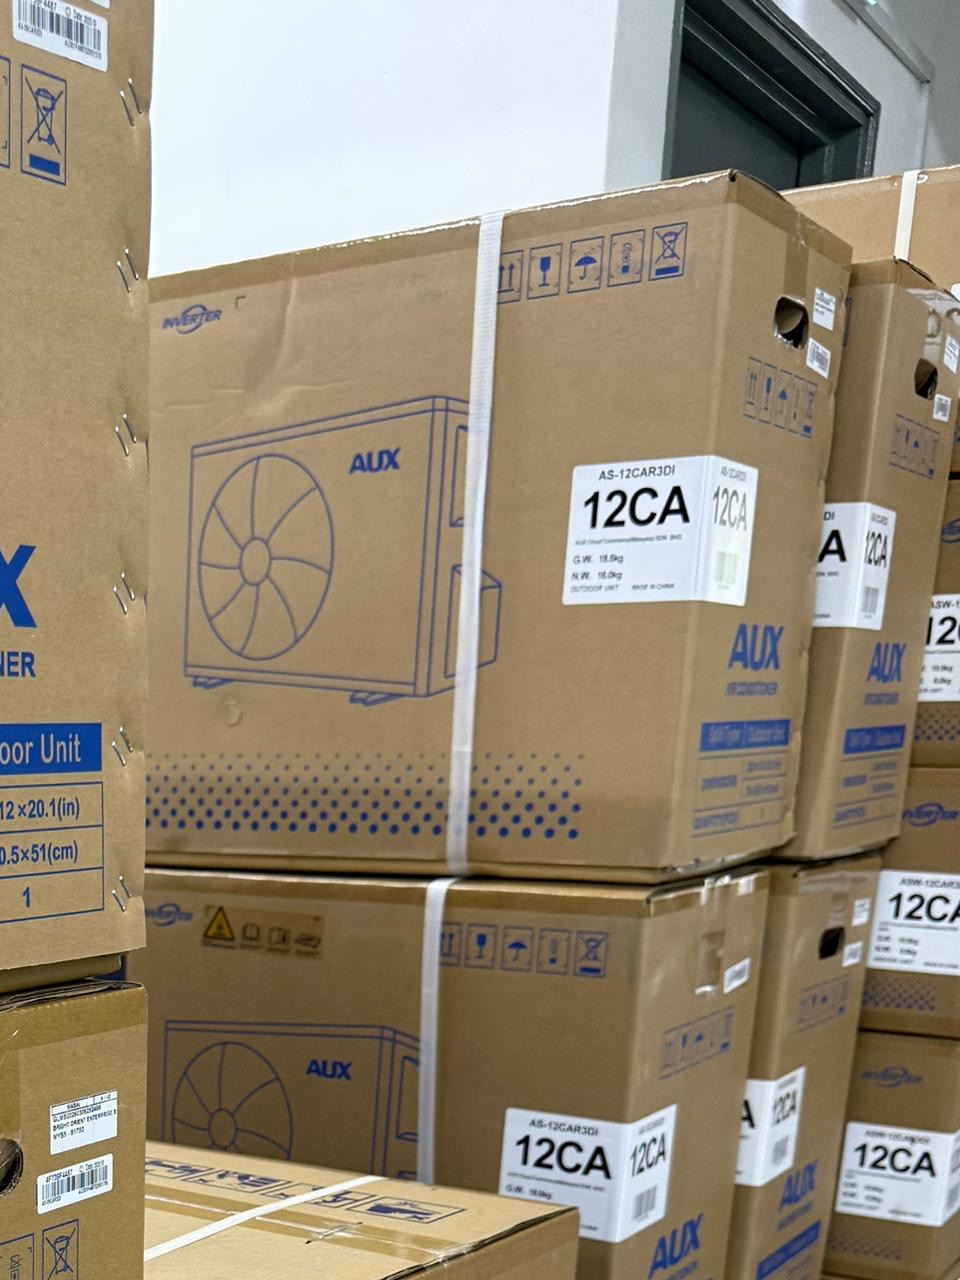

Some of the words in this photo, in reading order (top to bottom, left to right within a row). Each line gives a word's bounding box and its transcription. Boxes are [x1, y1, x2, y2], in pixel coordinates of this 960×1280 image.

[162, 308, 222, 332] INVERTER
[348, 447, 401, 475] AUX
[598, 465, 675, 481] AS-12CAR3DI
[584, 486, 690, 529] 12CA
[713, 486, 747, 531] 12CA
[865, 530, 887, 569] 12CA
[727, 623, 784, 671] AUX
[866, 642, 906, 683] AUX
[40, 732, 81, 763] Unit
[22, 886, 31, 908] 1
[305, 1059, 352, 1081] AUX
[529, 1118, 599, 1137] AS-12CAR3DI
[515, 1134, 612, 1180] 12CA
[631, 1133, 666, 1177] 12CA
[854, 1142, 936, 1178] 12CA
[778, 1159, 818, 1213] AUX
[647, 1212, 703, 1280] AUX
